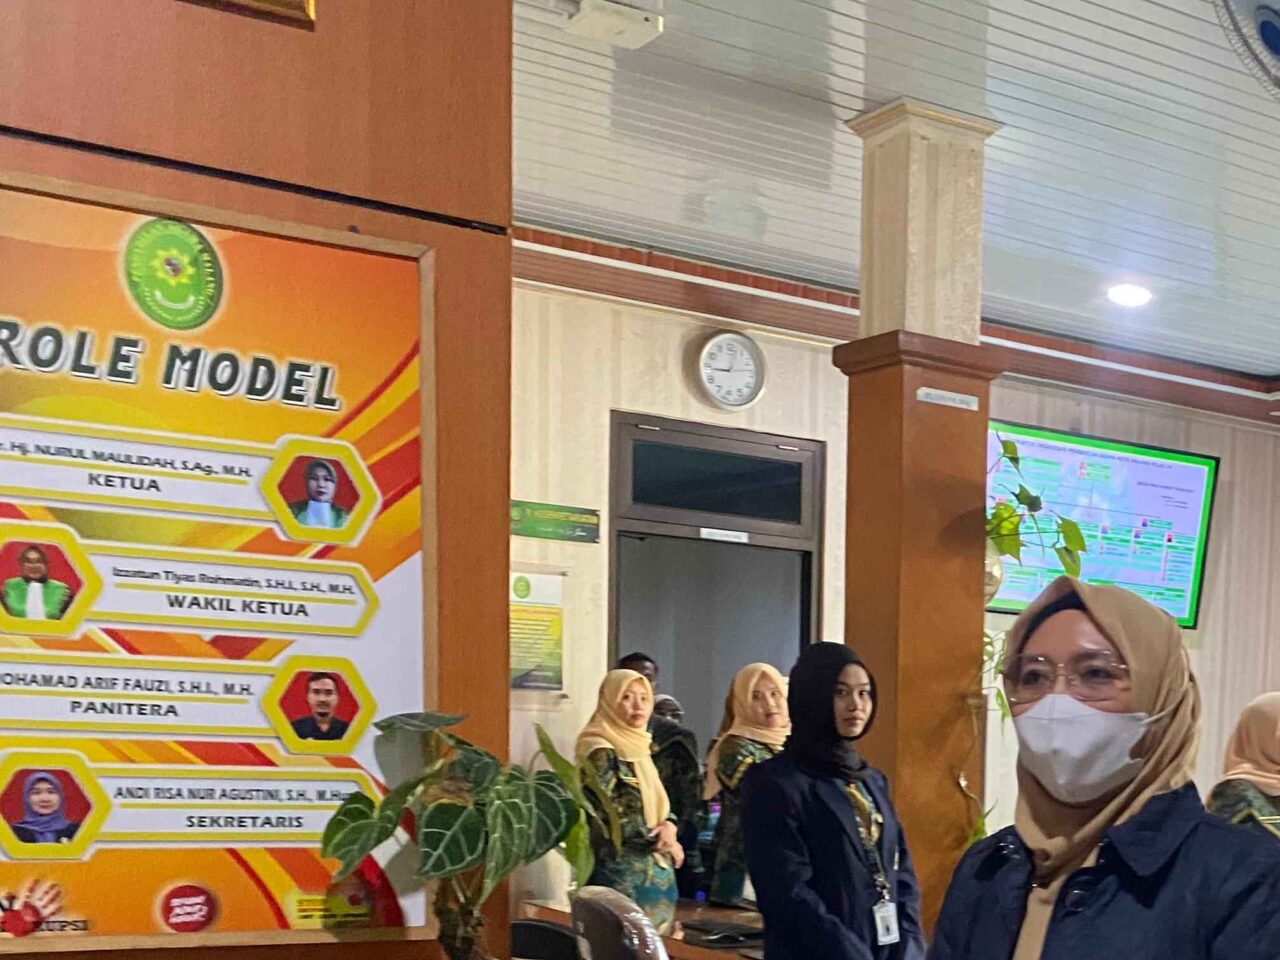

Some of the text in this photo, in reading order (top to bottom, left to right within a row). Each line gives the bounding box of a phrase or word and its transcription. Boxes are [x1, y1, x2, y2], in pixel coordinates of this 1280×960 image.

[0, 320, 340, 410] ROLE MODEL
[34, 444, 88, 459] NURUL
[88, 473, 161, 492] KETUA
[166, 594, 309, 617] WAKIL KETUA
[0, 673, 77, 688] OHAMAD
[82, 677, 118, 690] ARIF
[69, 700, 179, 717] PANITERA
[113, 787, 150, 799] ANDI
[153, 787, 183, 800] RISA
[187, 788, 216, 800] NUR
[186, 815, 304, 828] SEKRETARIS
